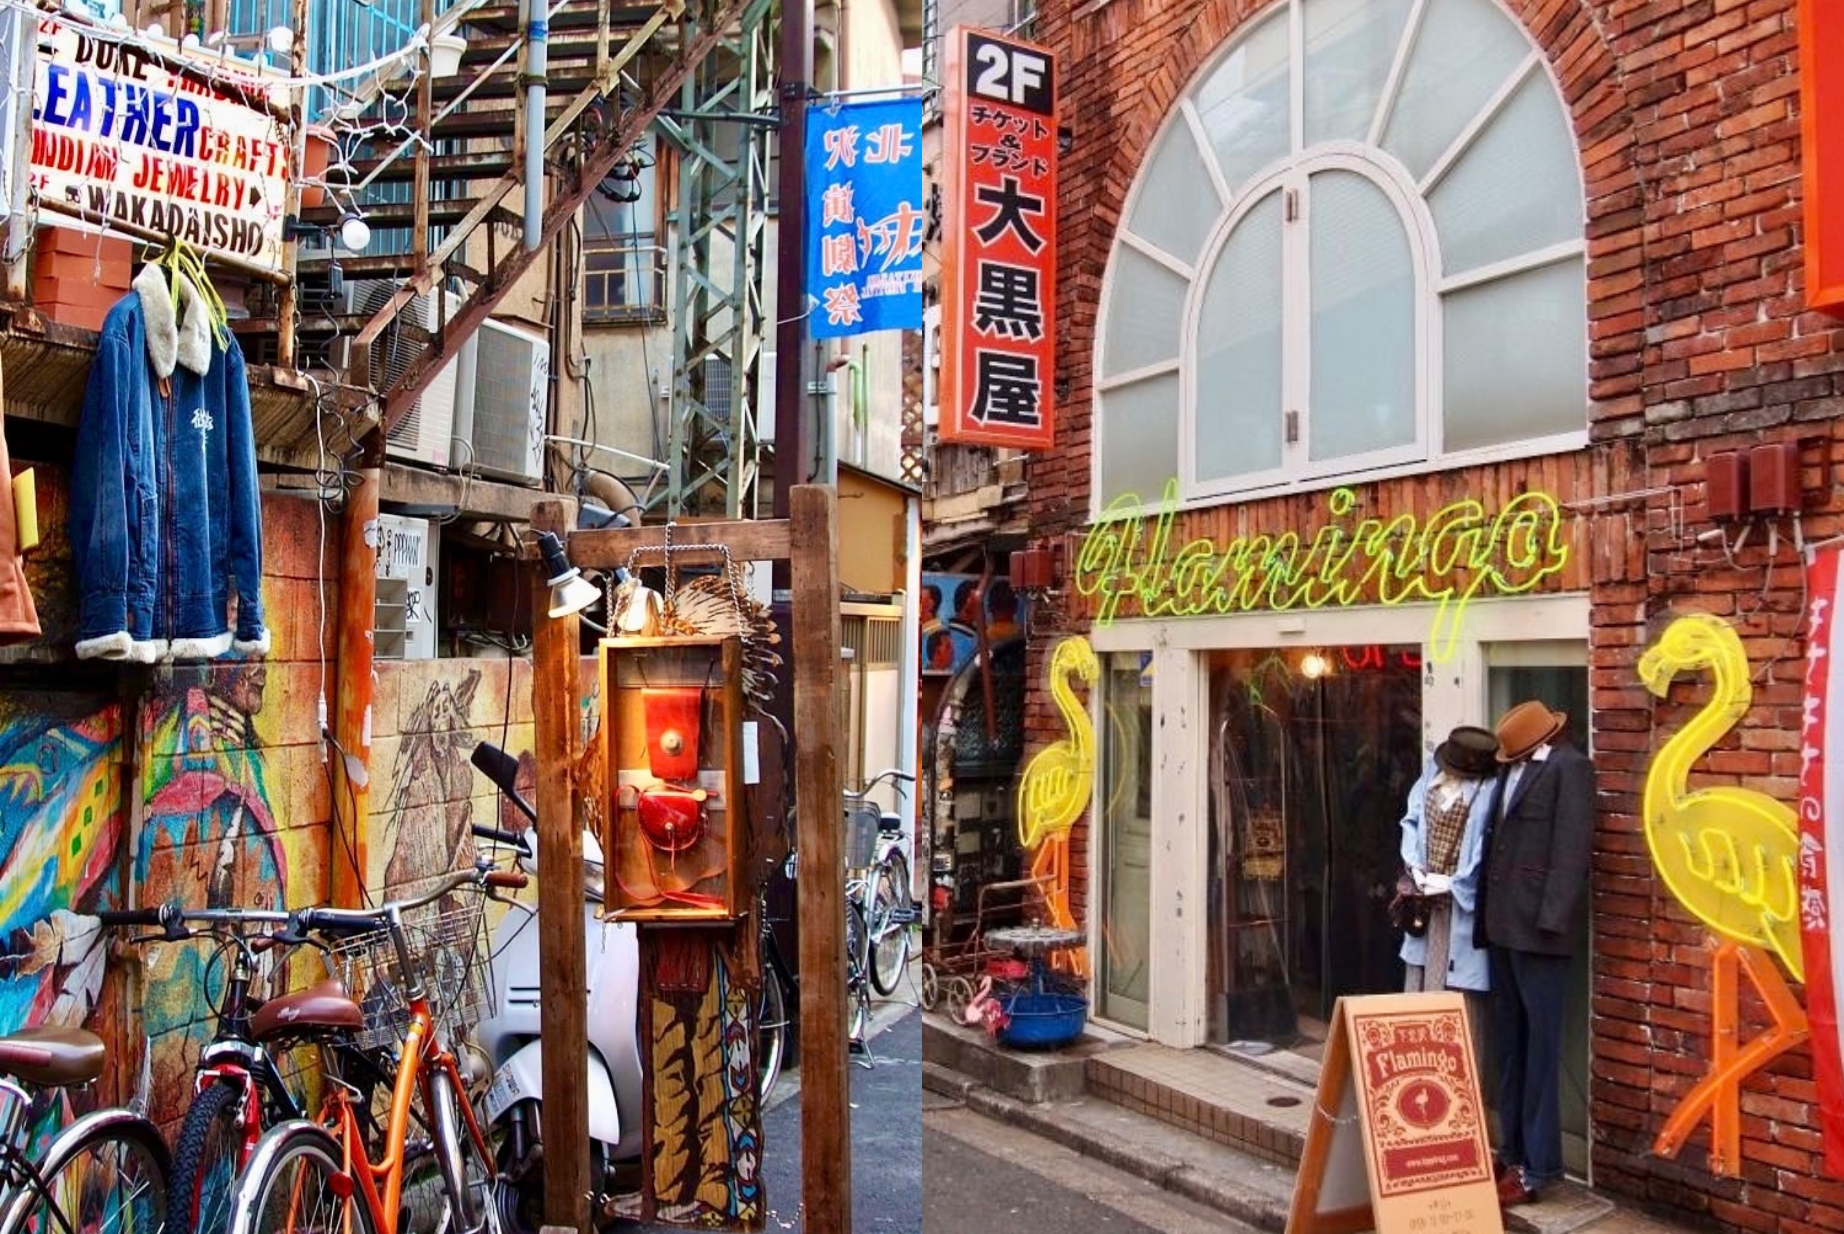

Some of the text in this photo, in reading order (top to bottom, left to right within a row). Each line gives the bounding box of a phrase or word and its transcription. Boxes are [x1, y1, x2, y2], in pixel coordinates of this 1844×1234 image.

[32, 62, 201, 159] EATHER
[978, 43, 1046, 105] 2F
[971, 105, 1048, 140] チケット
[1000, 133, 1022, 151] &
[30, 127, 246, 211] INDIAN JEWELRY
[969, 174, 1048, 429] 大黒屋
[1075, 478, 1570, 665] Flamingo
[1375, 1046, 1458, 1080] Flamingo
